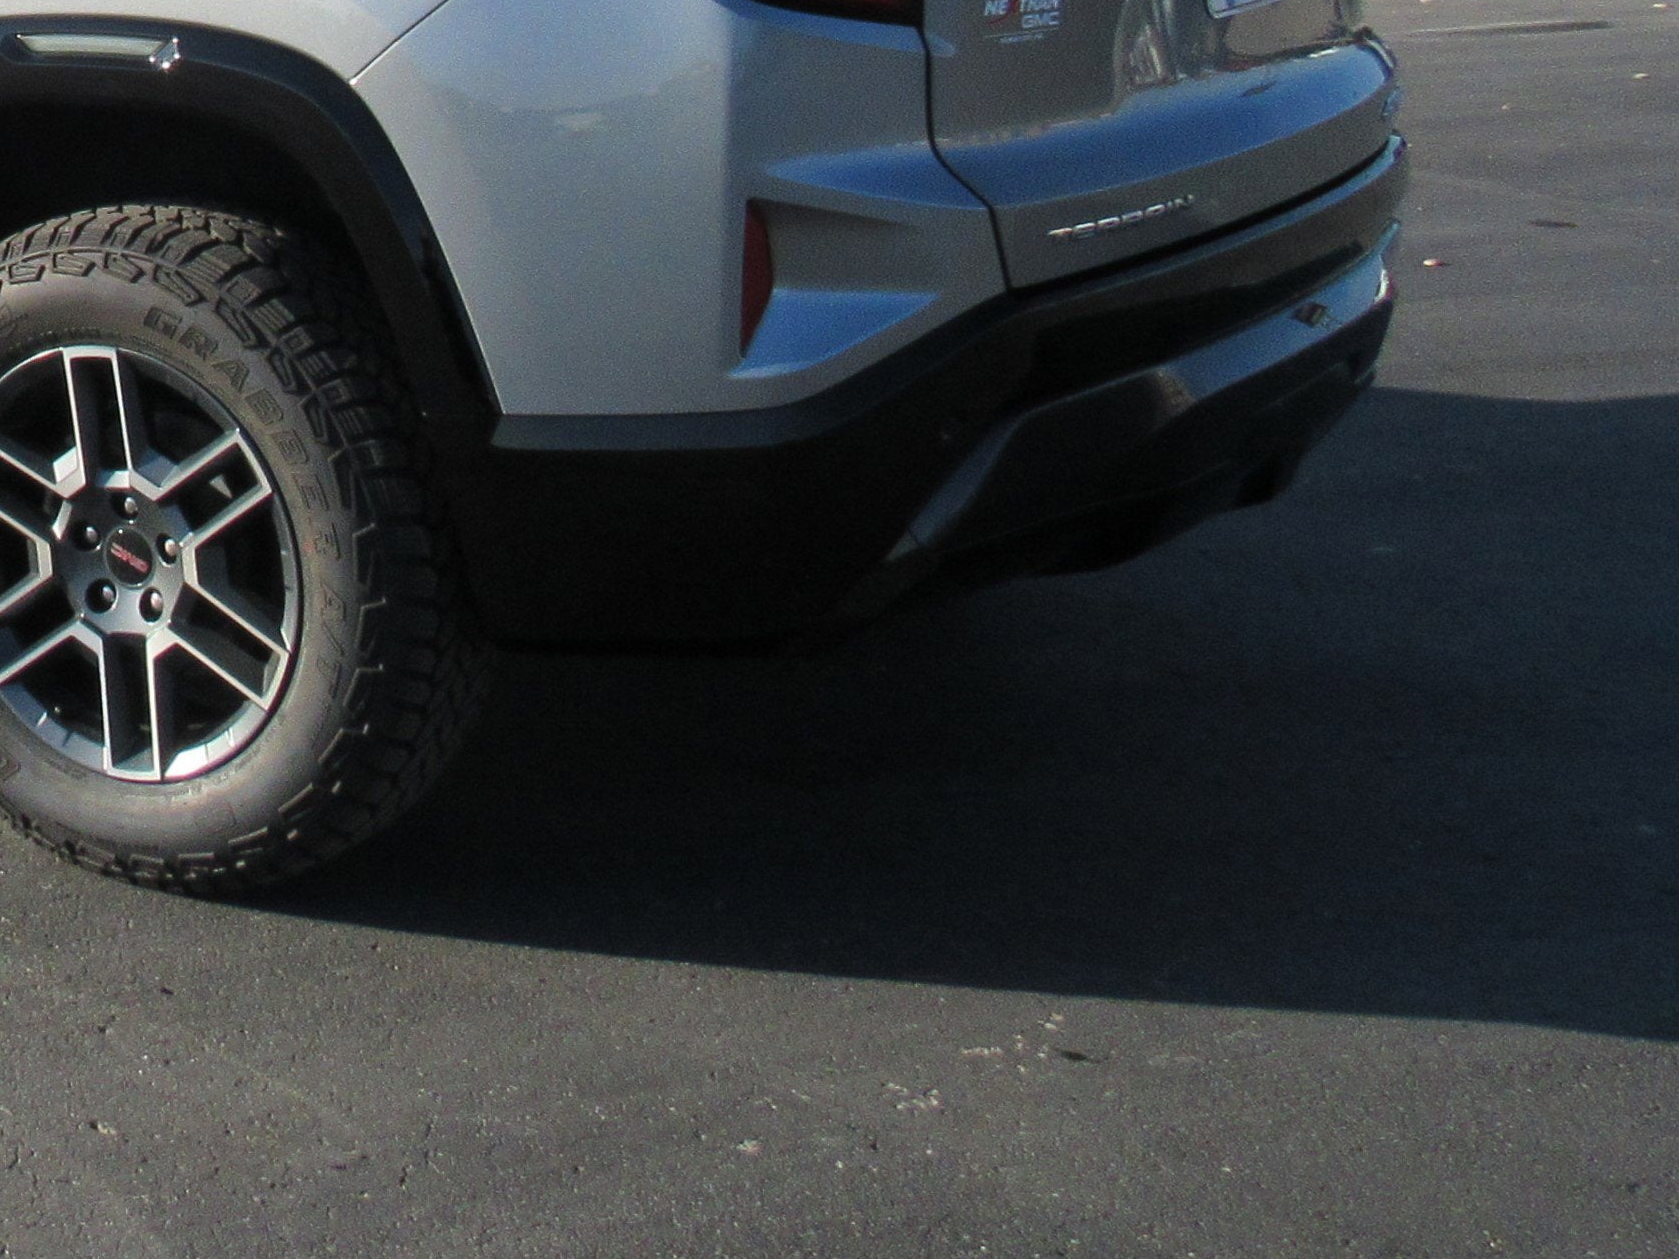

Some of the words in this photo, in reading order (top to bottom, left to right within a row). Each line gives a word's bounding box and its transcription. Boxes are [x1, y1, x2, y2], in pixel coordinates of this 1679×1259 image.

[1022, 11, 1060, 29] GMC
[1047, 193, 1194, 240] TERRAIN
[141, 304, 342, 564] GRABBER
